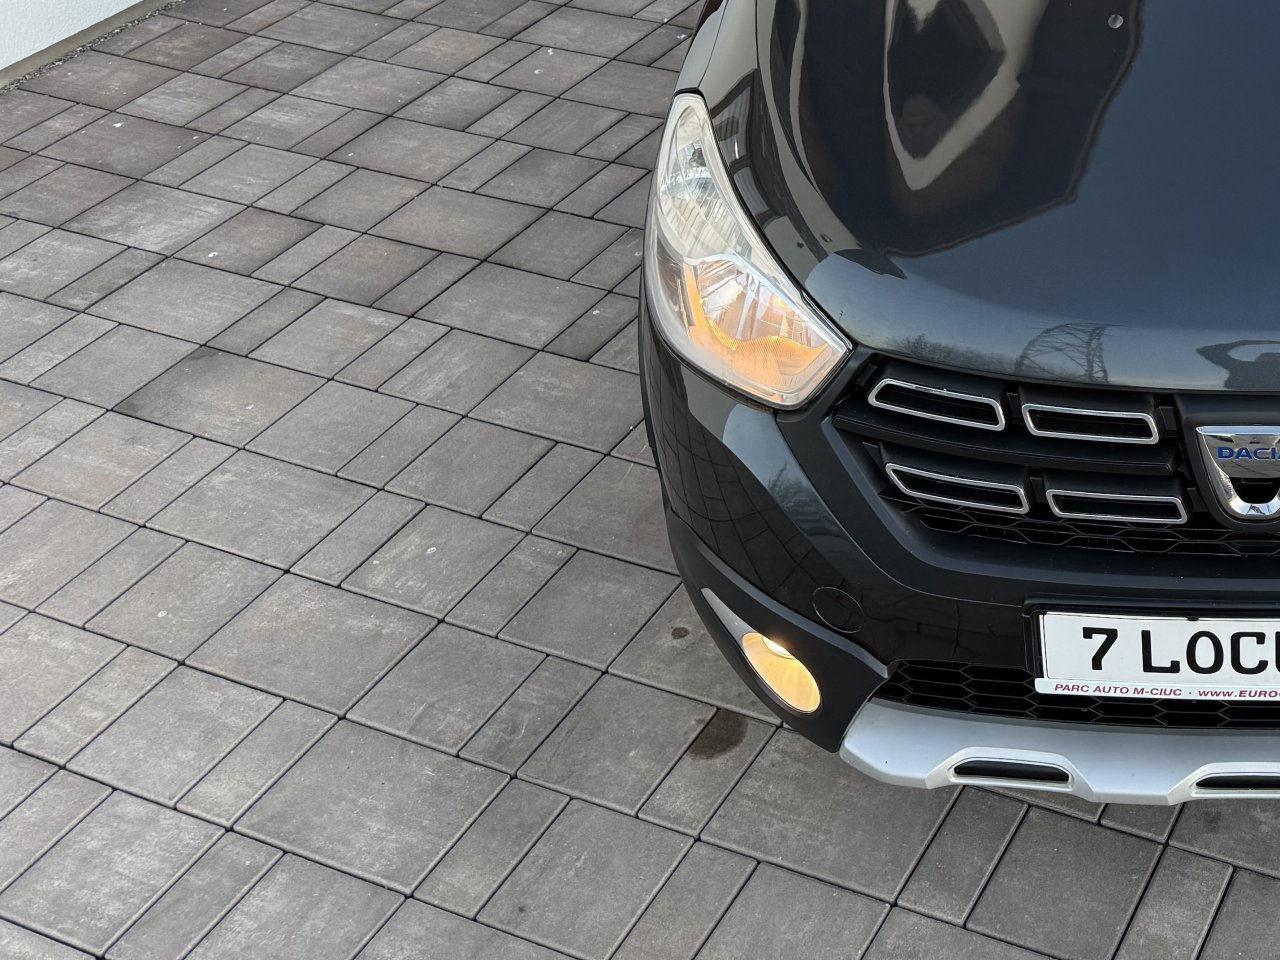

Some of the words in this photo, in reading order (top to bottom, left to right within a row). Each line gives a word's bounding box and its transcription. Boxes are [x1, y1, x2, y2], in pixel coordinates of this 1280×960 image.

[1082, 627, 1118, 670] 7
[1054, 683, 1090, 693] PARC
[1093, 685, 1130, 695] AUTO
[1133, 687, 1183, 696] M-CIUC
